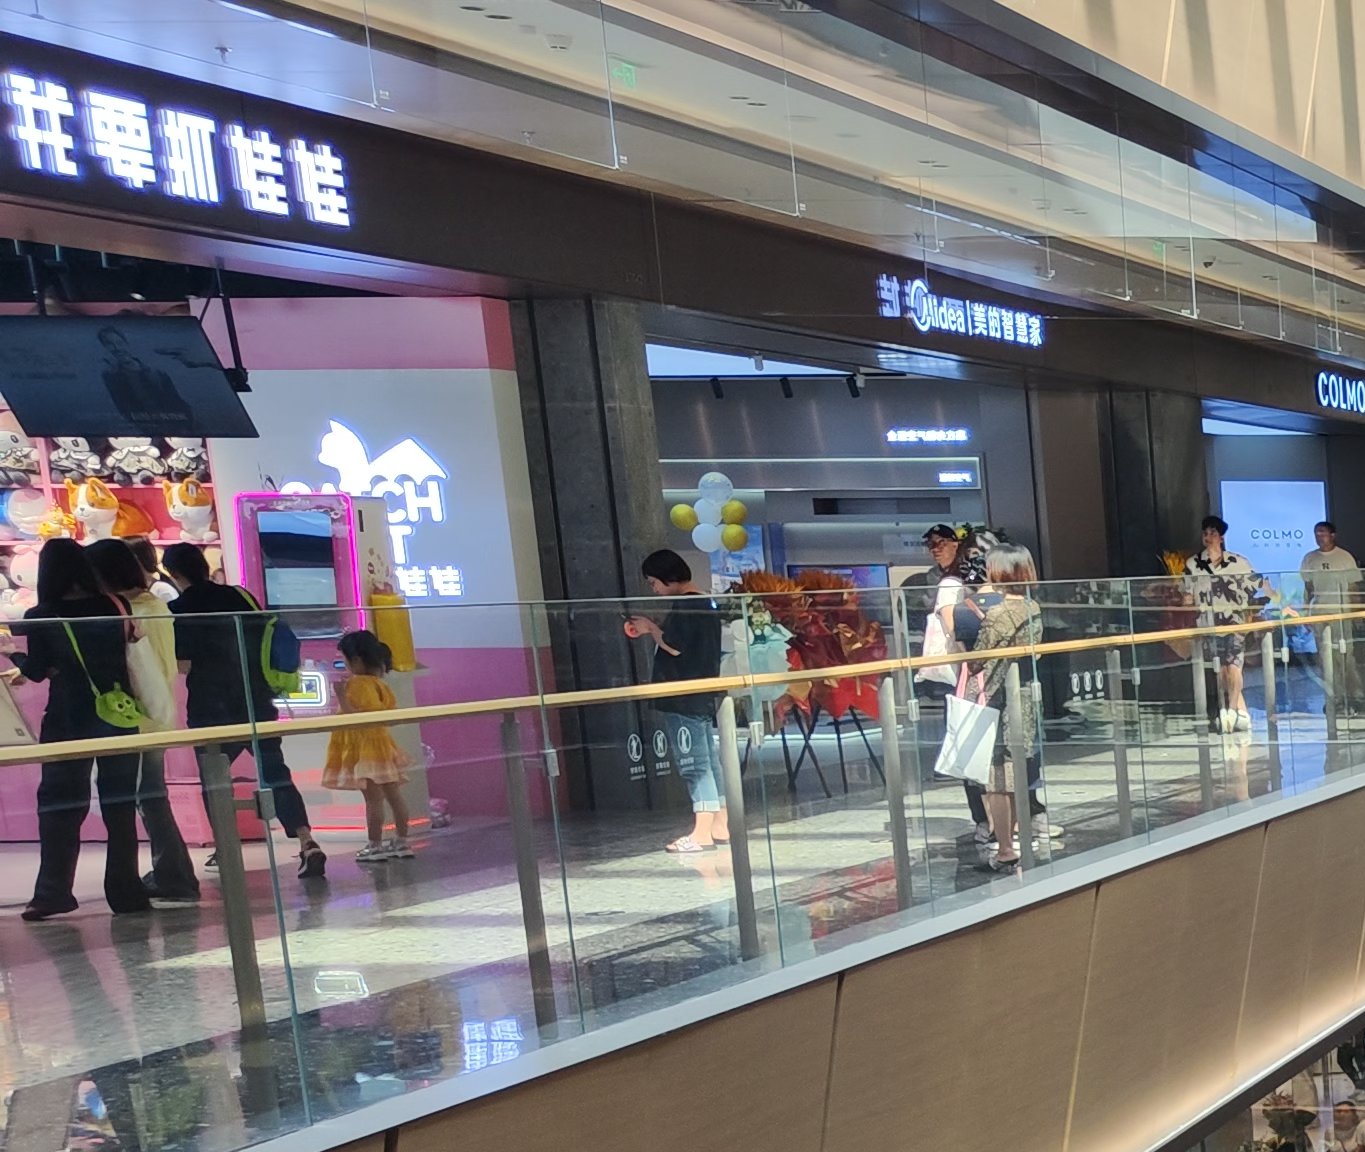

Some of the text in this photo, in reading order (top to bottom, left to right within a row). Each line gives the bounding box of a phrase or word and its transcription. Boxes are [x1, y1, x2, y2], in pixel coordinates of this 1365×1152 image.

[3, 72, 350, 227] 我要抓娃娃
[973, 302, 1043, 347] 美的智慧家
[1250, 529, 1304, 540] COLMO
